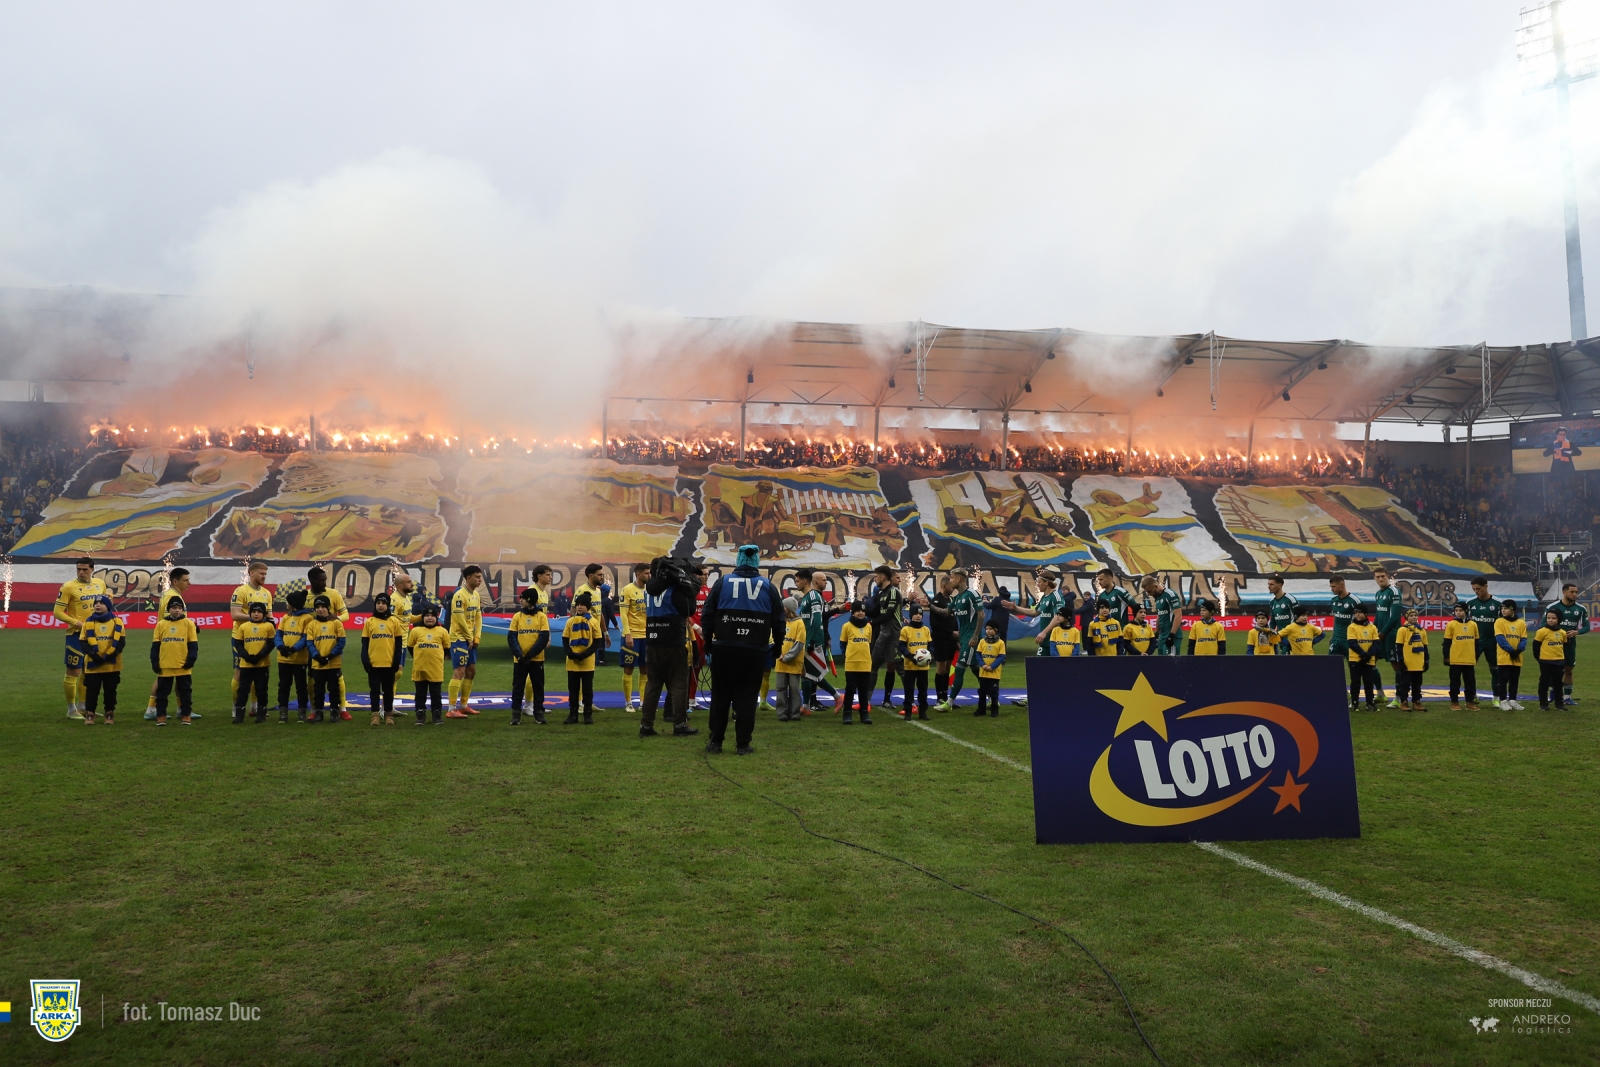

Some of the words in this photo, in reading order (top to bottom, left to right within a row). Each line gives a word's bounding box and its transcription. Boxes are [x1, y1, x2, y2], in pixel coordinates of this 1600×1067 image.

[729, 578, 763, 600] TV
[736, 628, 750, 636] 137
[67, 655, 79, 666] 99
[624, 654, 634, 664] 29
[1134, 724, 1276, 800] LOTTO
